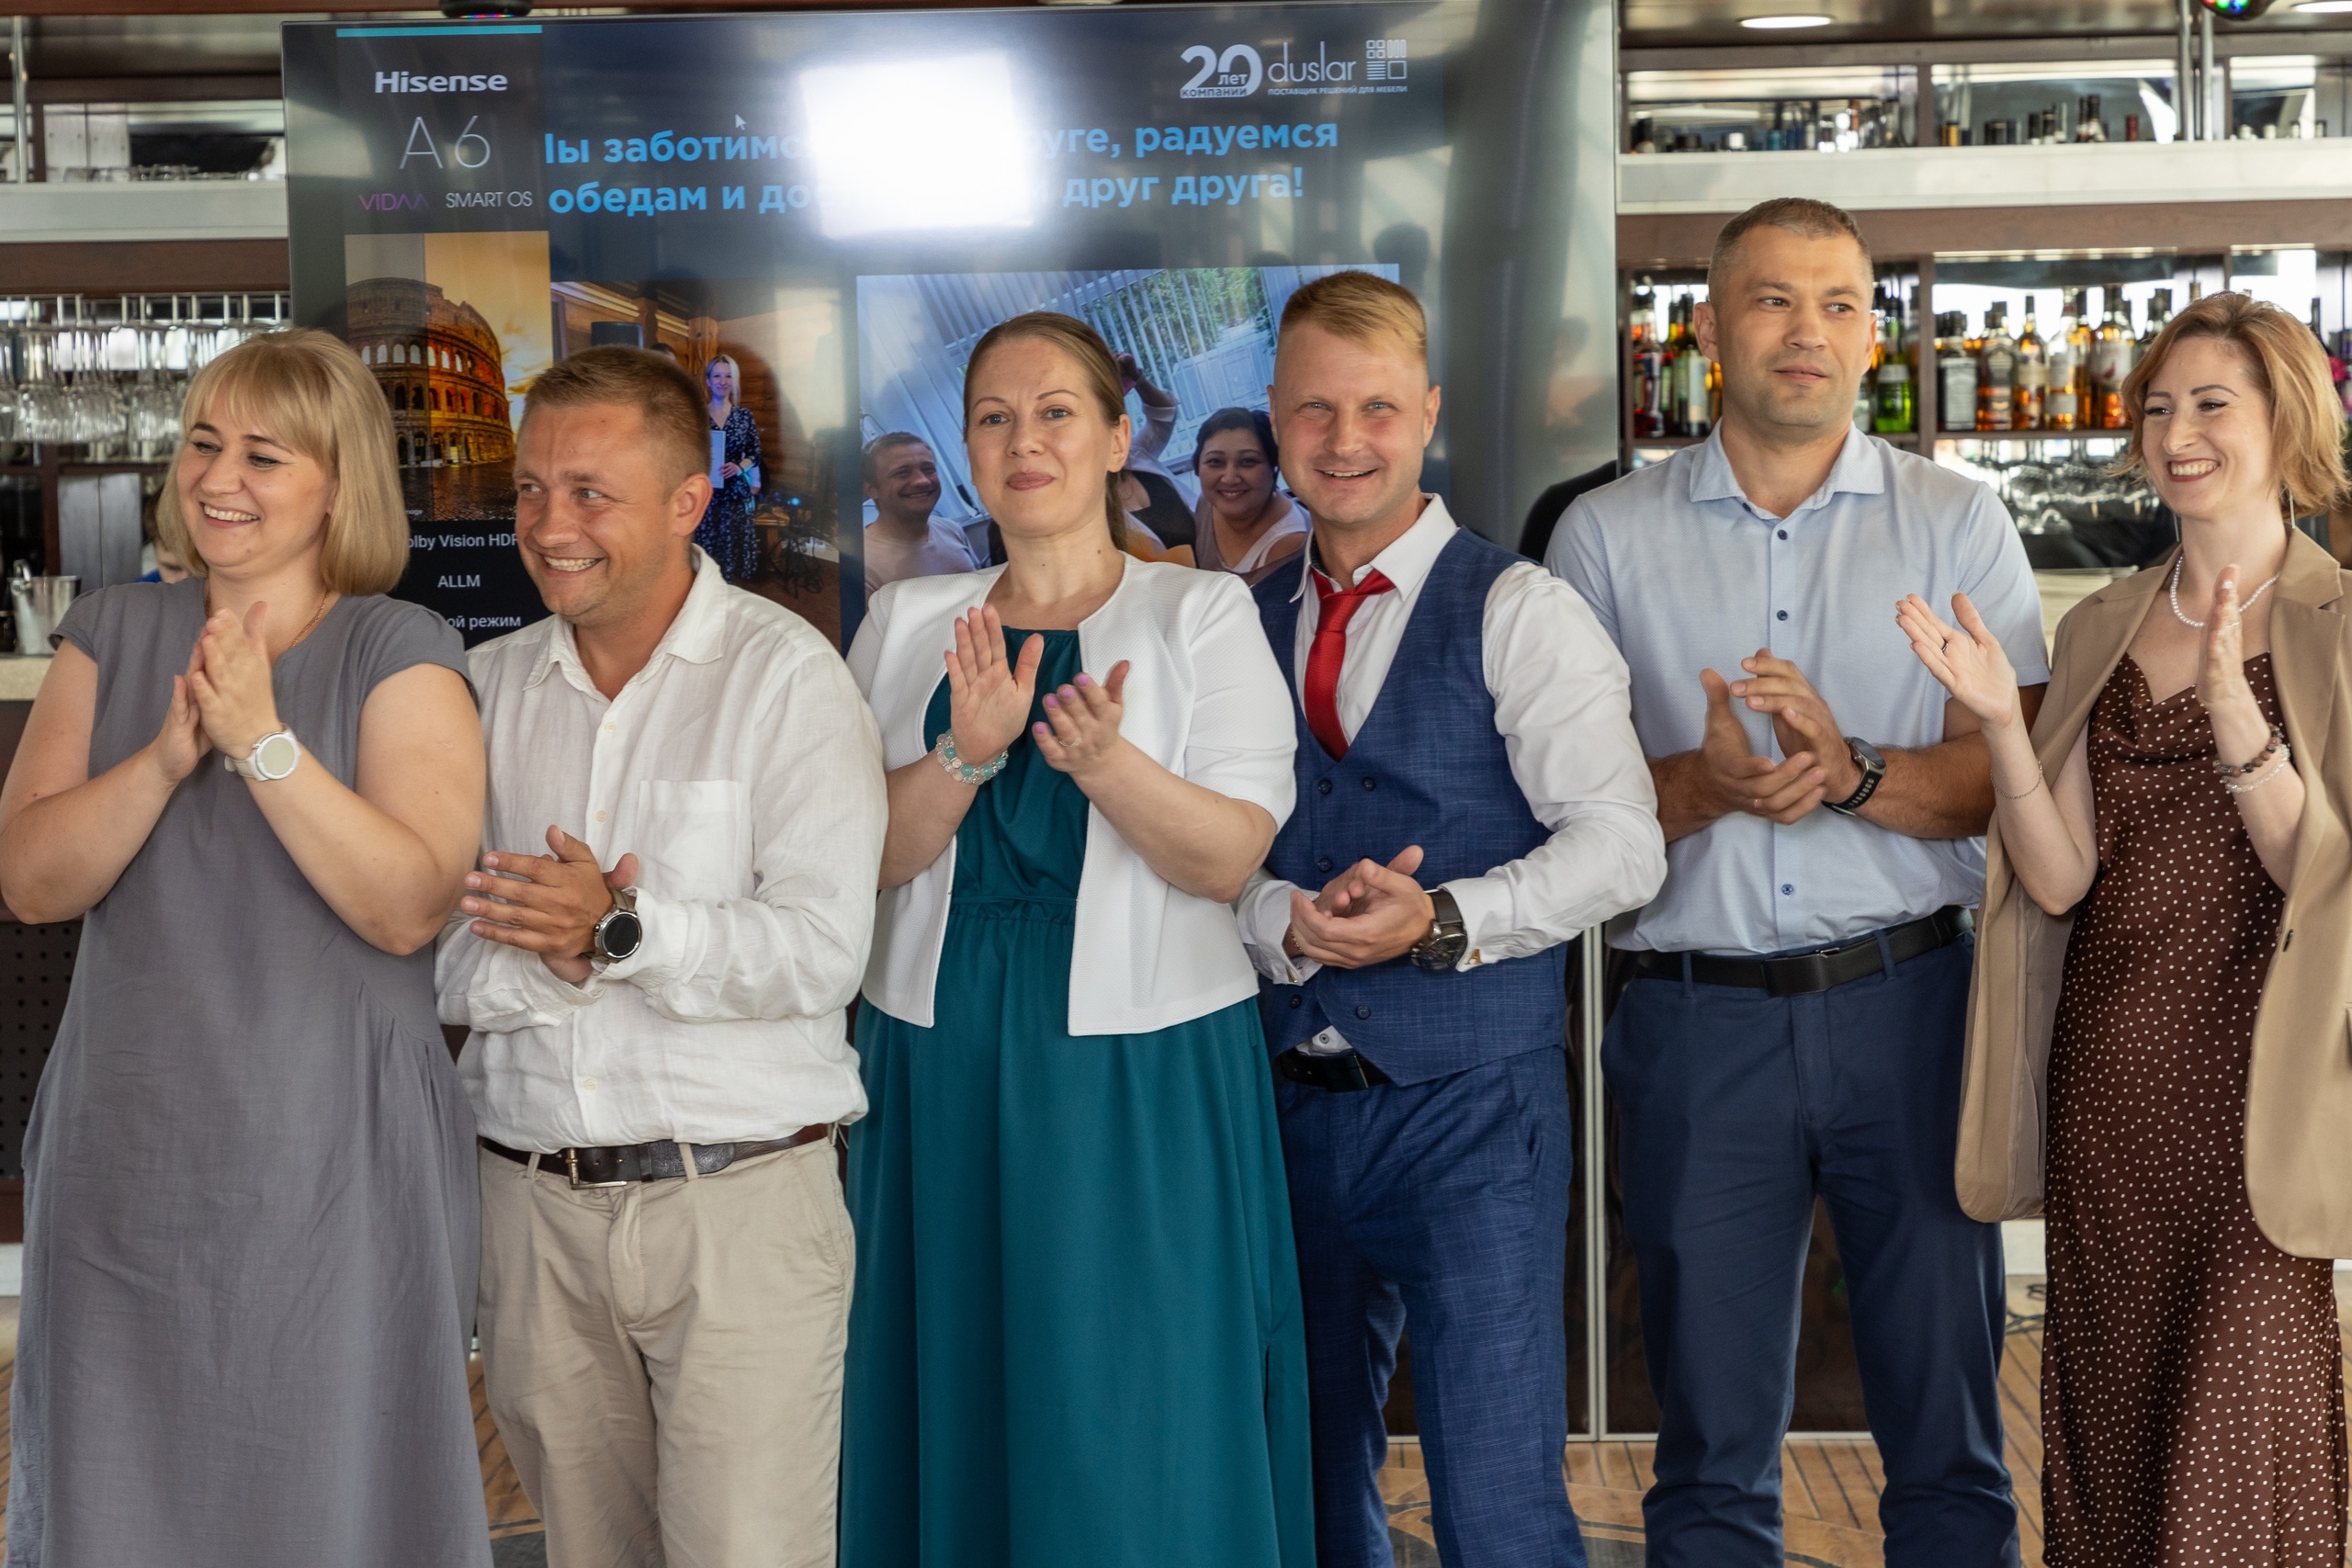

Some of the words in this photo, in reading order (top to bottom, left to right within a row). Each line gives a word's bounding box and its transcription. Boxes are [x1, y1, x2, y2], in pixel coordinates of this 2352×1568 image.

[1180, 43, 1263, 98] 20
[1268, 41, 1356, 83] duslar
[375, 71, 508, 93] Hisense
[1217, 73, 1248, 85] лет
[1182, 88, 1248, 97] компании
[545, 133, 590, 164] ы
[1136, 123, 1338, 158] радуемся
[1062, 176, 1159, 209] друг
[1171, 166, 1304, 206] друга!
[446, 191, 503, 209] SMART
[507, 191, 533, 208] OS
[548, 181, 707, 217] обедам
[722, 186, 745, 209] и
[408, 535, 436, 551] olby
[438, 535, 485, 547] Vision
[436, 574, 481, 588] ALLM
[469, 616, 522, 631] режим
[1464, 947, 1483, 965] A
